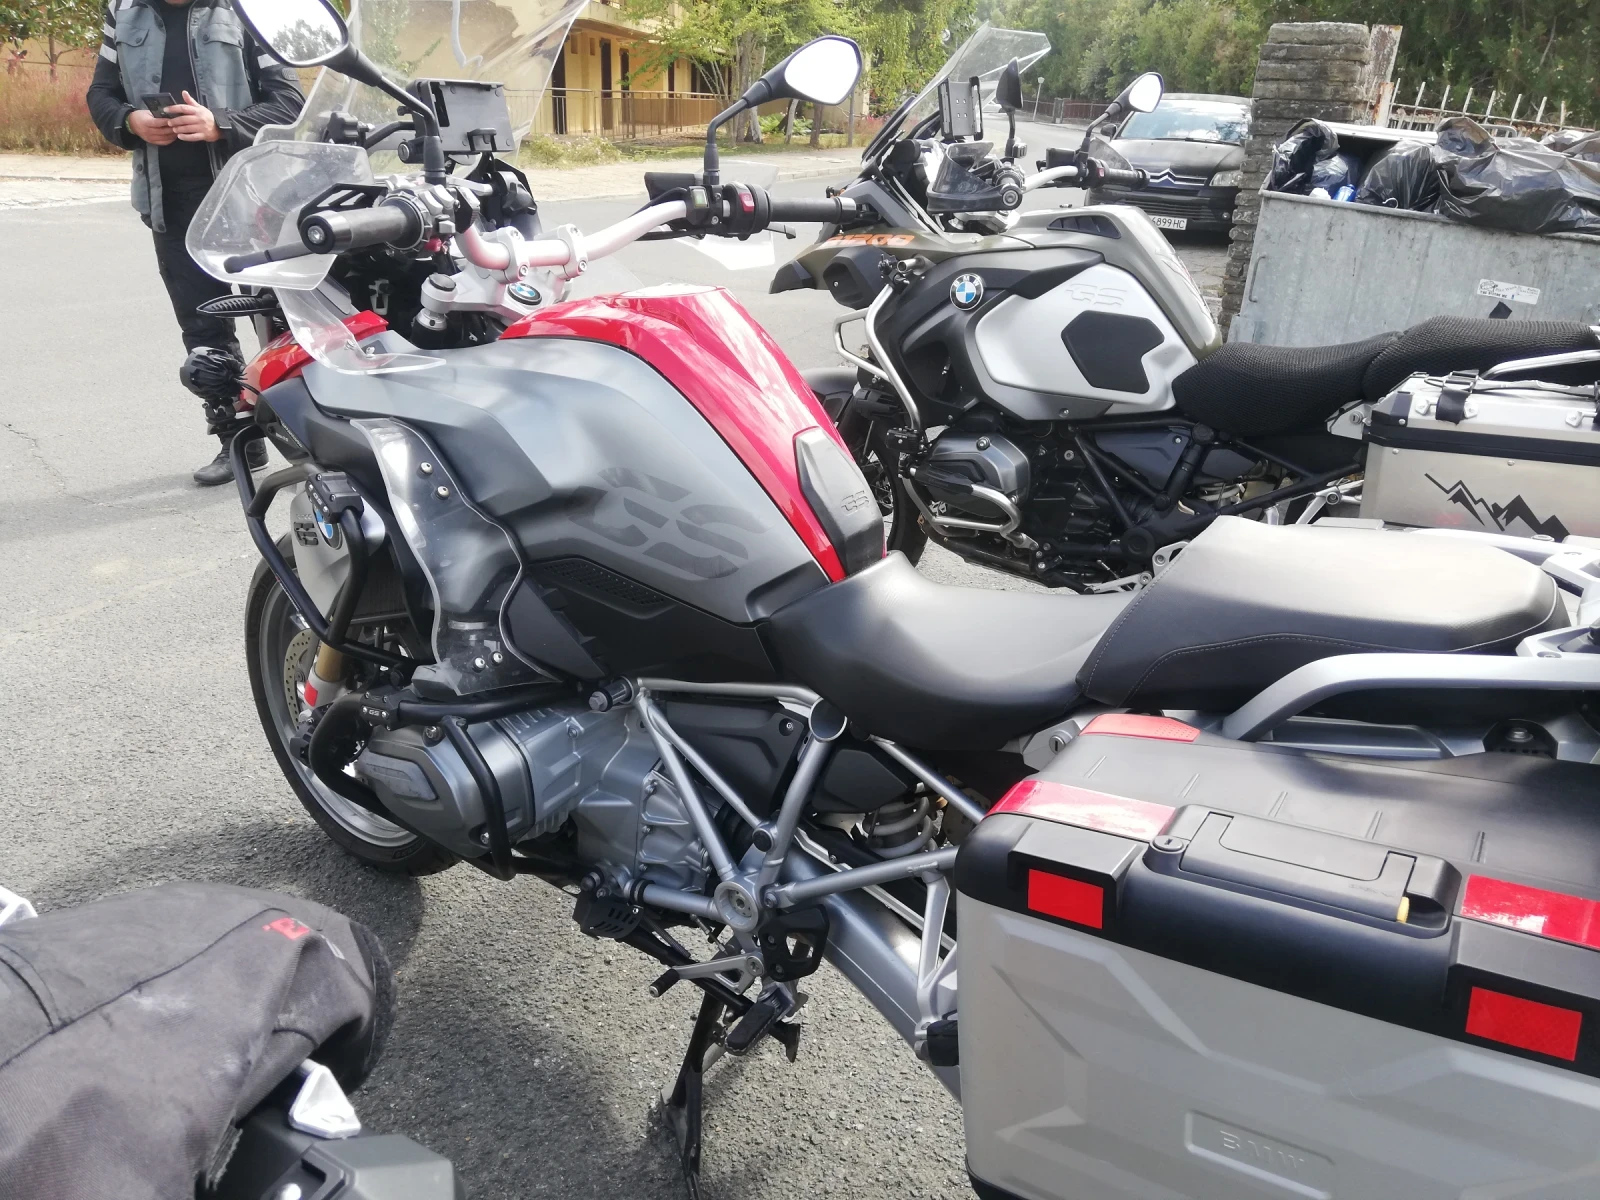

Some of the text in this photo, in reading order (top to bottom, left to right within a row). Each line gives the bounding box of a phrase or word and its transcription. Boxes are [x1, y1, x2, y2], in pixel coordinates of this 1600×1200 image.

[1065, 283, 1128, 307] GS
[568, 467, 774, 579] GS
[368, 709, 380, 717] GS
